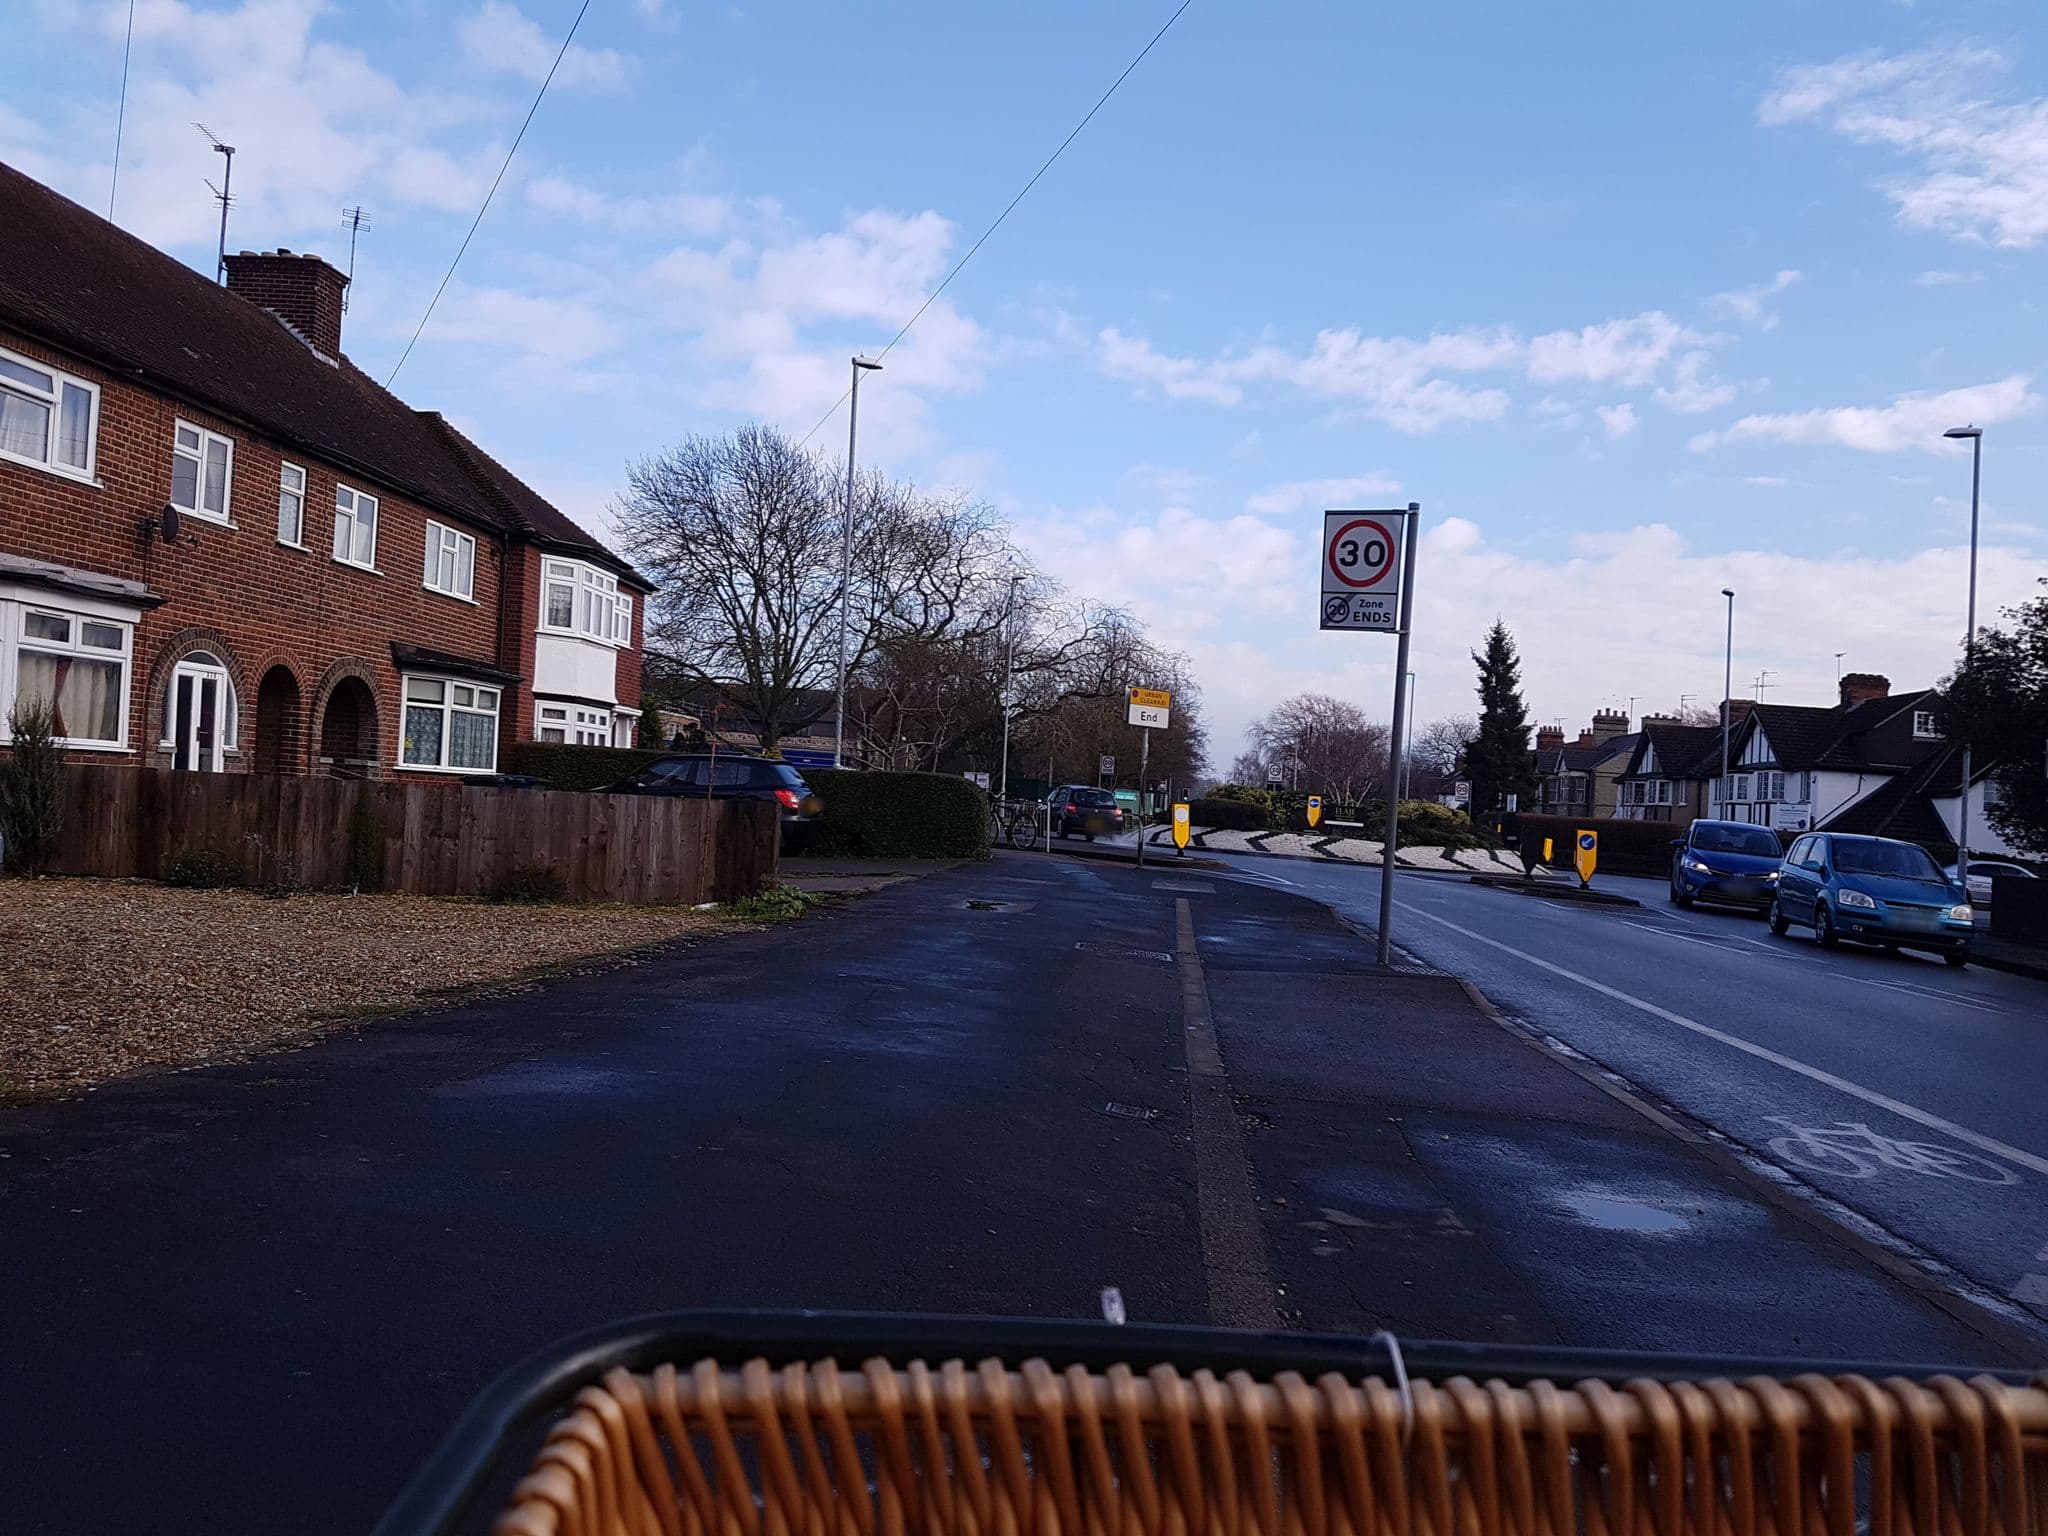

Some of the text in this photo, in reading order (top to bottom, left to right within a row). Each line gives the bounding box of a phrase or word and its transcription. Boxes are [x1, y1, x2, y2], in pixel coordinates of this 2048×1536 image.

[1339, 540, 1386, 567] 30
[1328, 603, 1346, 616] 20
[1359, 599, 1384, 609] Zone
[1353, 611, 1392, 623] ENDS
[1141, 711, 1158, 722] End
